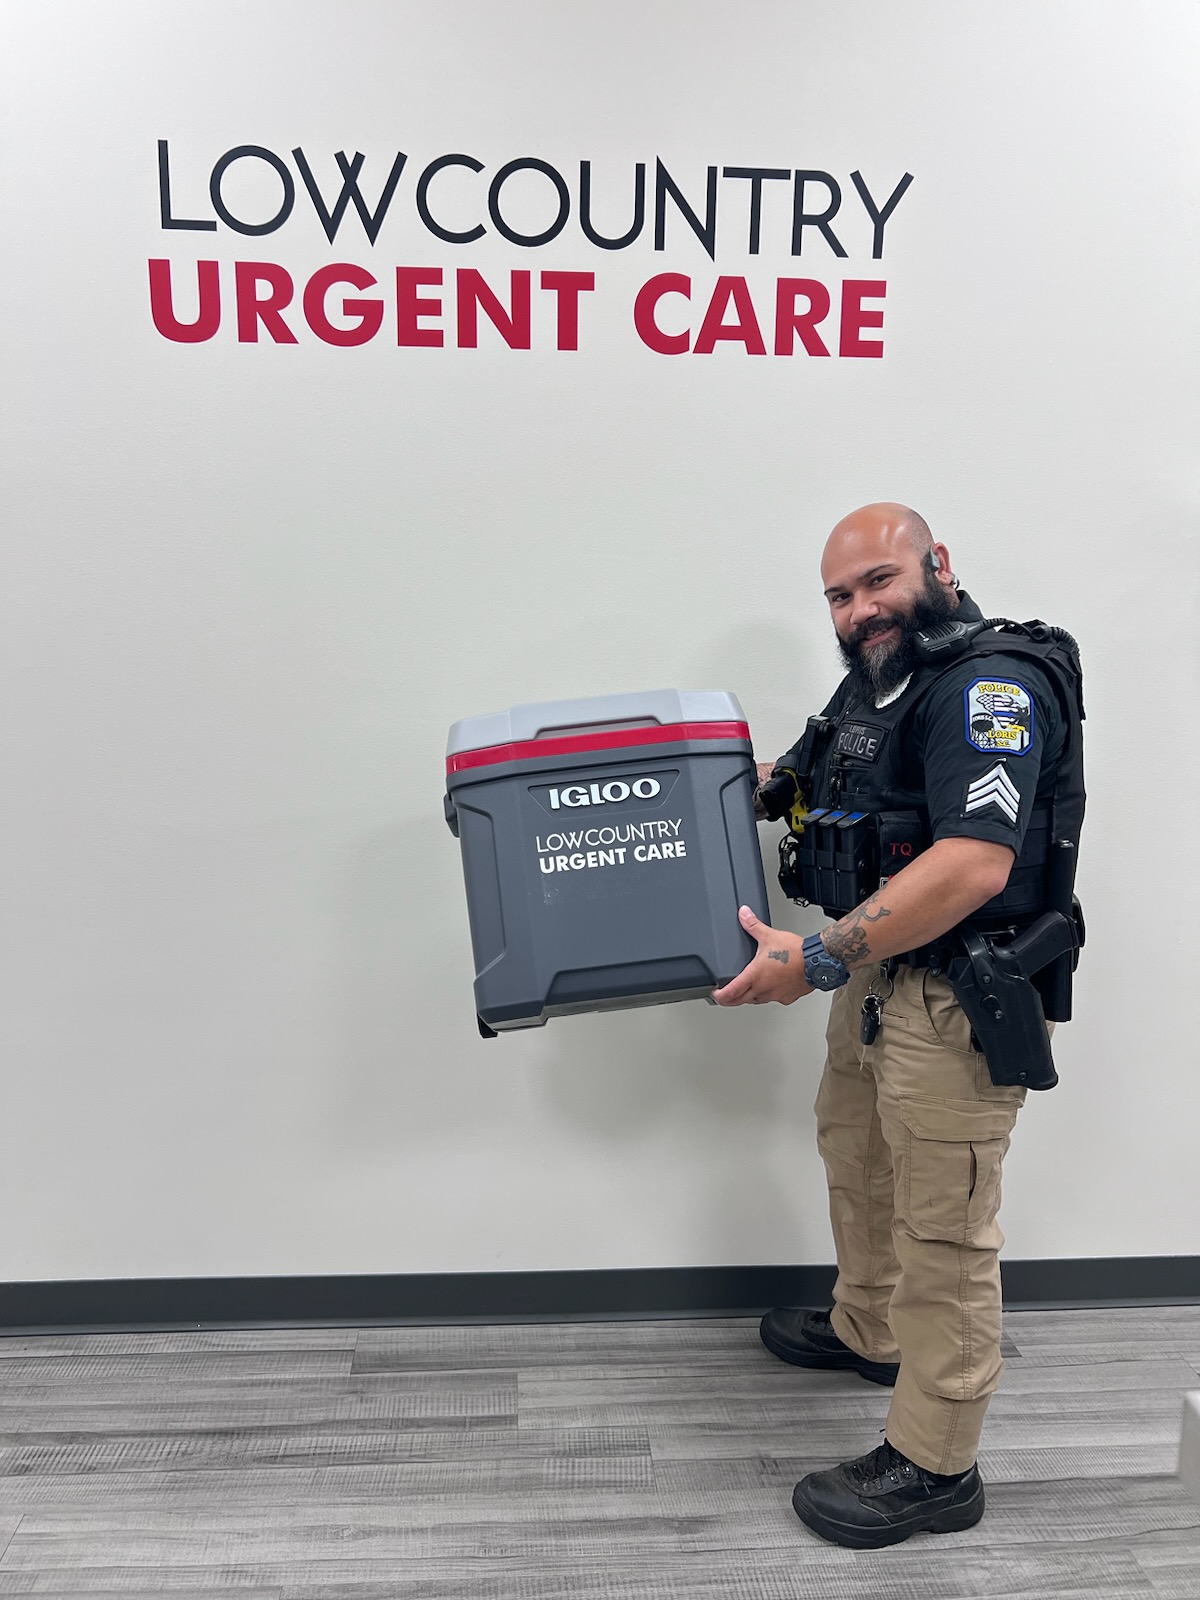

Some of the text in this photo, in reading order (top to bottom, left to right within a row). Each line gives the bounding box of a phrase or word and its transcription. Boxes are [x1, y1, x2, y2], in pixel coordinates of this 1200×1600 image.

[158, 140, 914, 261] LOWCOUNTRY
[149, 259, 887, 358] URGENT CARE
[977, 683, 1021, 696] POLICE
[838, 732, 877, 756] POLICE
[988, 730, 1017, 740] LORIS
[549, 778, 661, 809] IGLOO
[536, 819, 682, 853] LOWCOUNTRY
[890, 843, 912, 857] TQ
[539, 841, 687, 874] URGENT CARE
